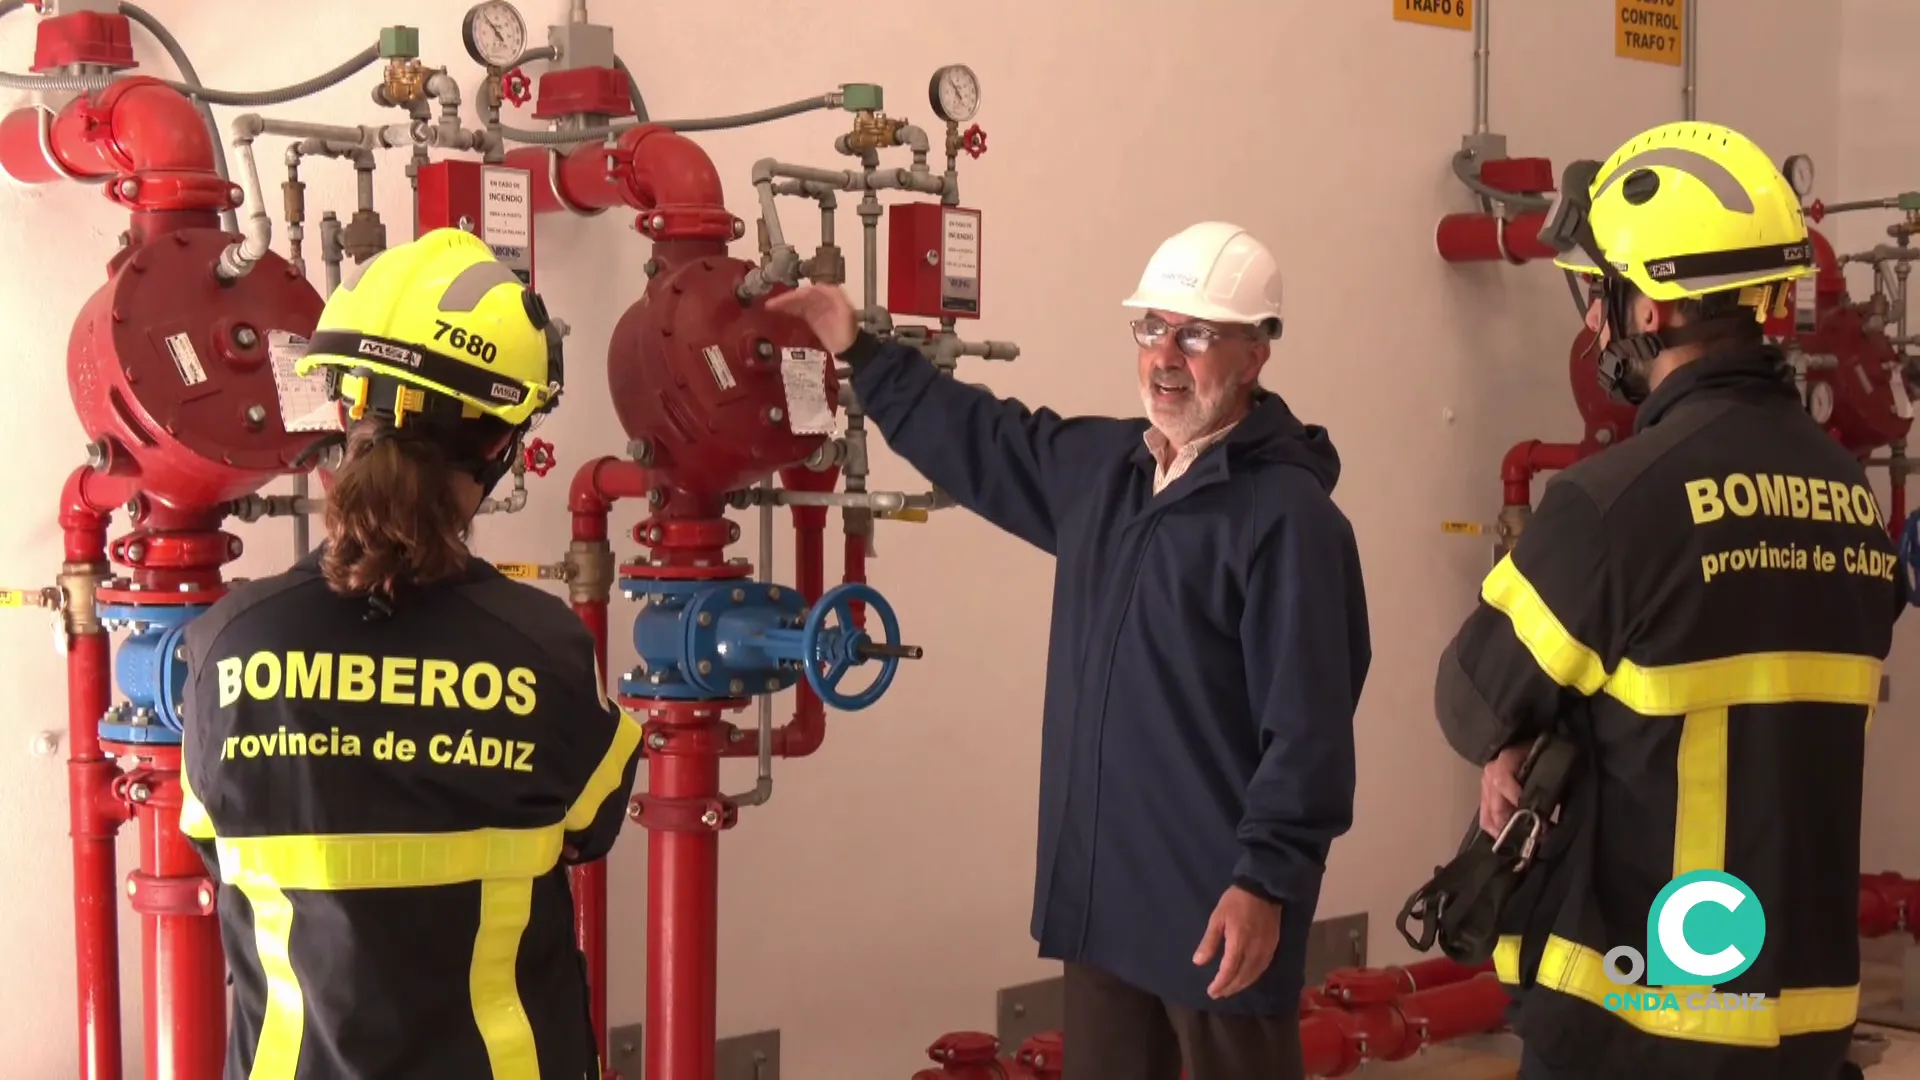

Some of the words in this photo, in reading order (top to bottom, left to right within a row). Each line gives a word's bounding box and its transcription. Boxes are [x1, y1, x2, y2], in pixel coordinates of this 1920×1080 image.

[1456, 0, 1465, 17] 6
[1621, 7, 1679, 30] CONTROL
[1624, 30, 1665, 51] TRAFO
[1668, 36, 1676, 52] 7
[489, 192, 523, 204] INCENDIO
[432, 320, 498, 364] 7680
[493, 385, 519, 401] MSA
[1701, 540, 1807, 583] provincia
[1813, 545, 1836, 572] de
[1843, 542, 1898, 582] CÁDIZ
[217, 651, 537, 716] BOMBEROS
[373, 730, 416, 762] de
[429, 729, 537, 773] CÁDIZ
